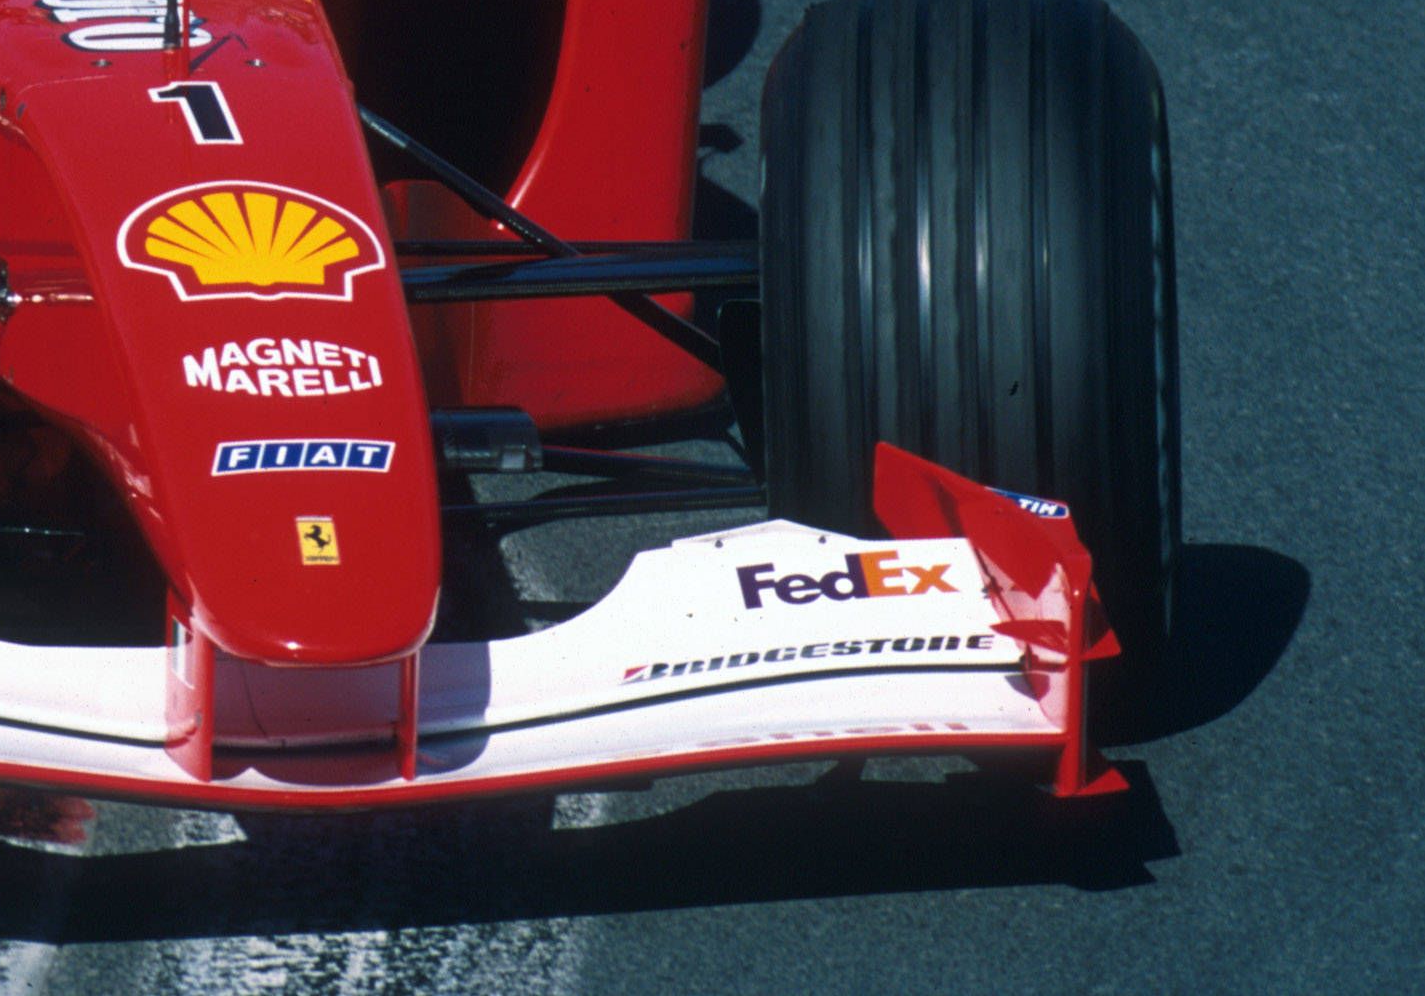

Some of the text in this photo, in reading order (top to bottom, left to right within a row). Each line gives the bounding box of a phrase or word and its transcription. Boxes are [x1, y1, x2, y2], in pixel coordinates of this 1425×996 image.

[148, 81, 244, 144] 1
[182, 337, 382, 391] MAGNETI
[182, 347, 382, 397] MARELLI
[227, 444, 381, 470] FIAT
[1018, 498, 1058, 516] TIM
[736, 550, 959, 609] FedEx
[619, 633, 995, 685] BRIDGESTONE
